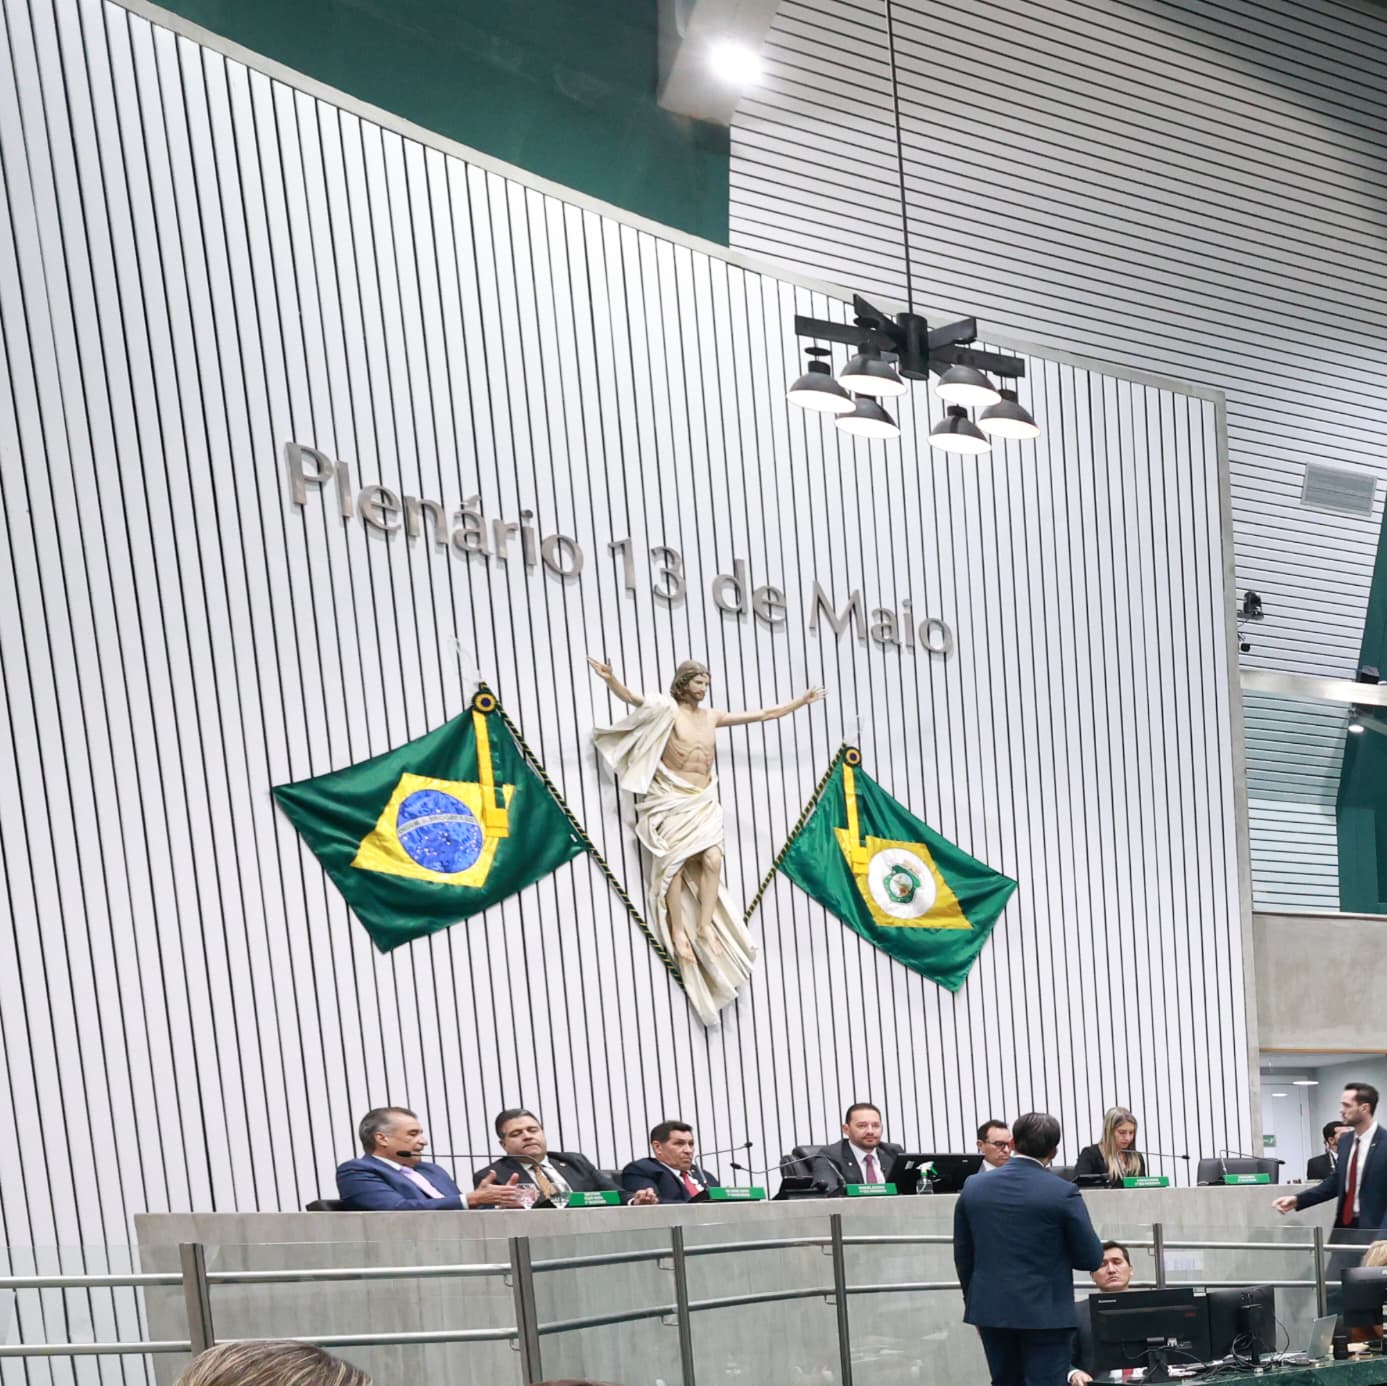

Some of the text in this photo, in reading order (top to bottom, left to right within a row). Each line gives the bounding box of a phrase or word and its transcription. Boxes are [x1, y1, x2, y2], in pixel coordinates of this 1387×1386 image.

[286, 442, 954, 653] Plenário 13 de Maio
